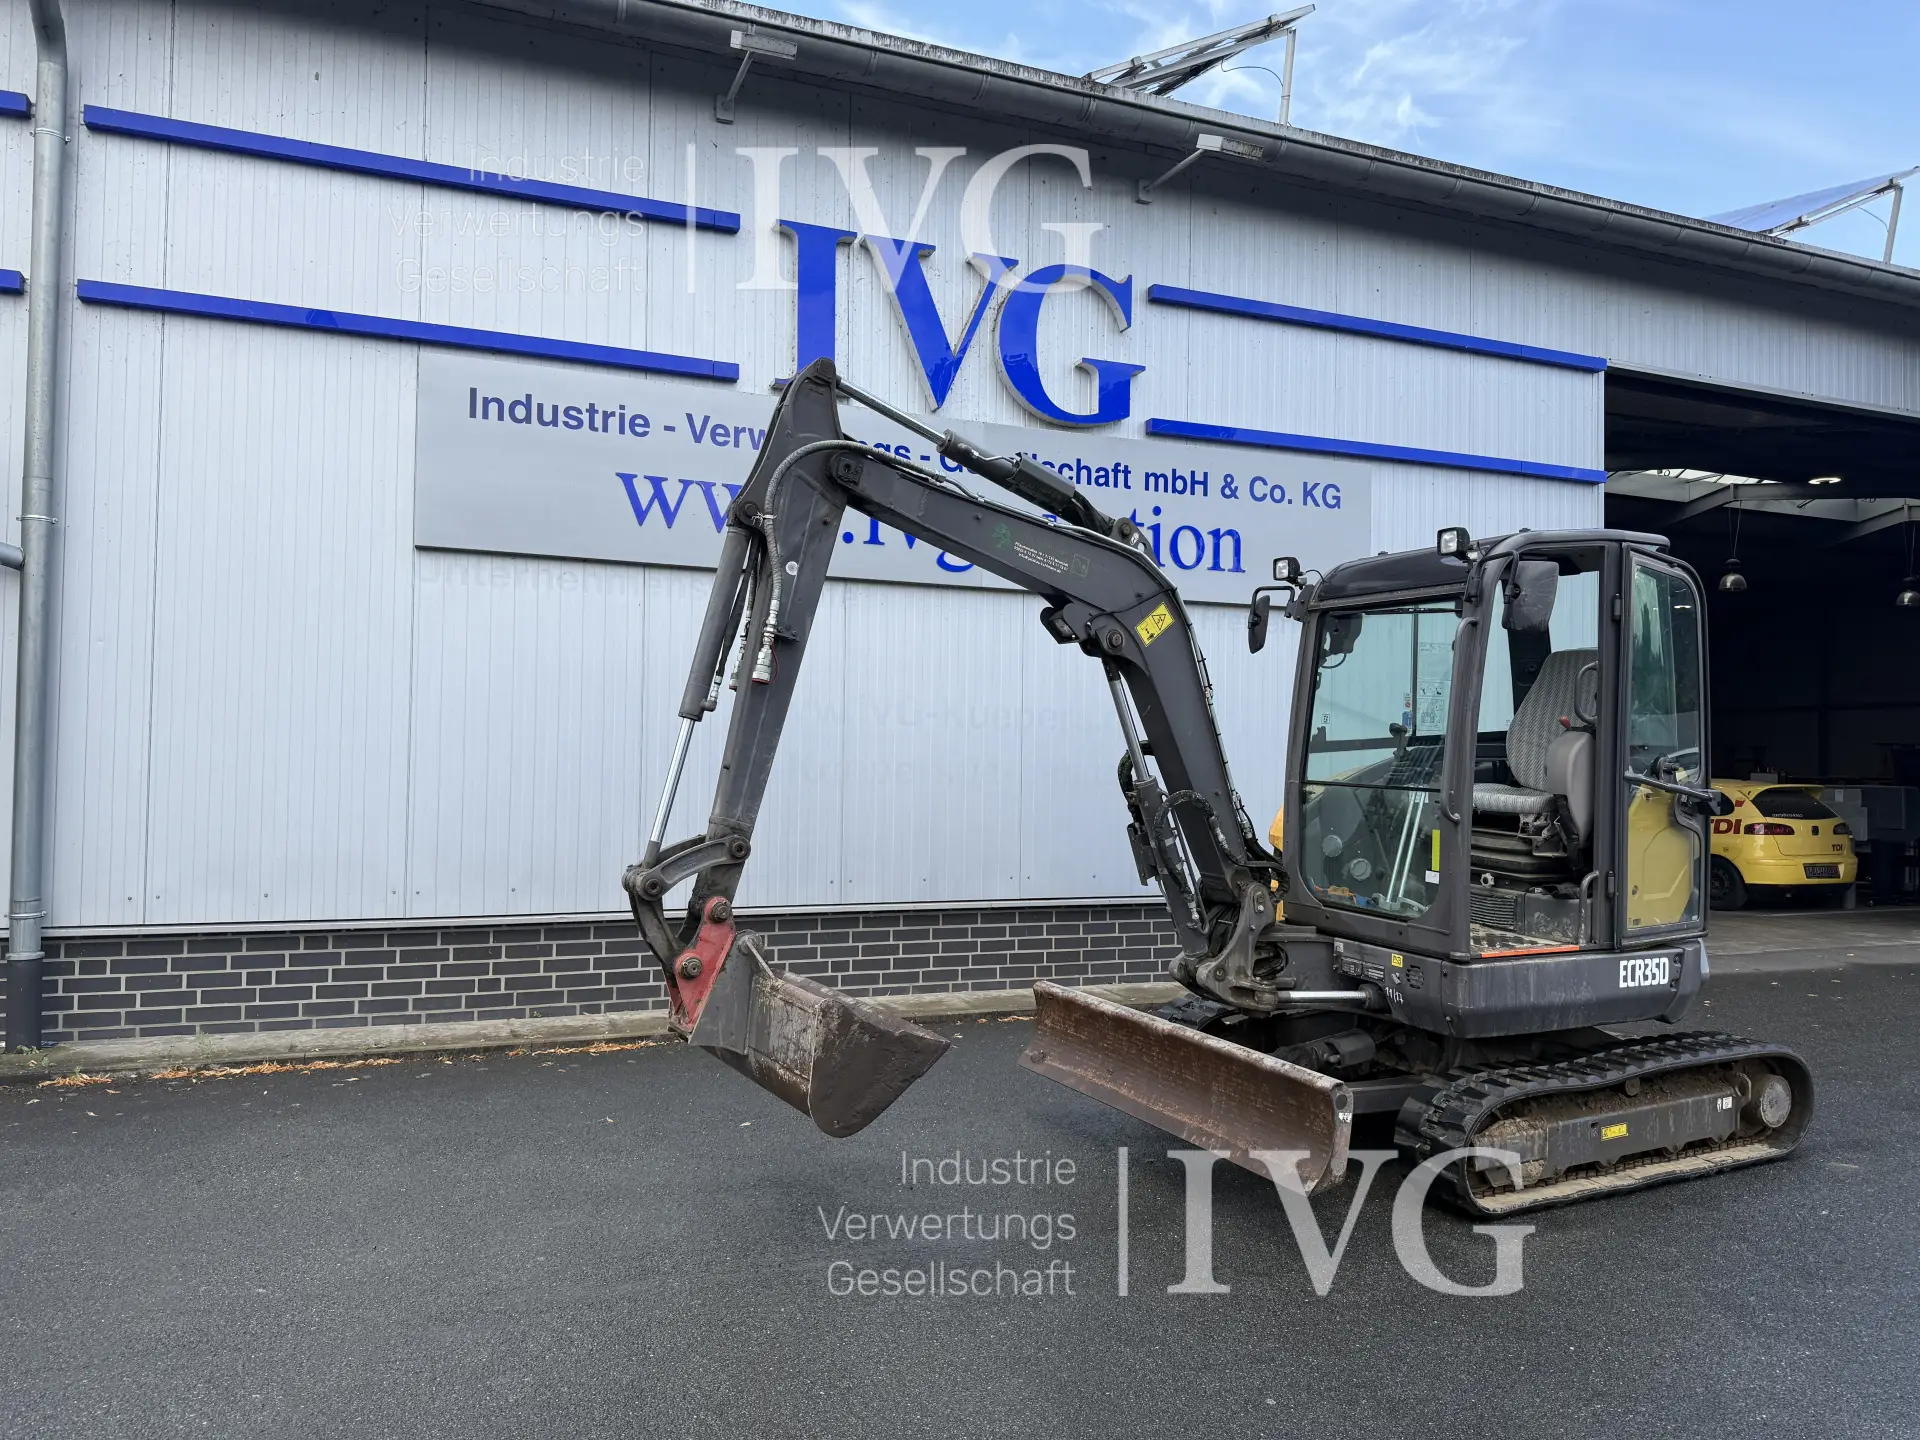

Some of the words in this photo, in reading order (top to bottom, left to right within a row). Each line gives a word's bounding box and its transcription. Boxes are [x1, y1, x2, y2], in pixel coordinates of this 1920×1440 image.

[771, 219, 1146, 428] IVG
[468, 387, 651, 437] Industrie
[1144, 468, 1208, 496] mbH
[1220, 473, 1239, 500] &
[1249, 476, 1293, 505] Co.
[1303, 481, 1341, 509] KG
[1710, 818, 1742, 834] DI
[1831, 844, 1843, 852] TDI
[1619, 957, 1669, 988] ECR35D
